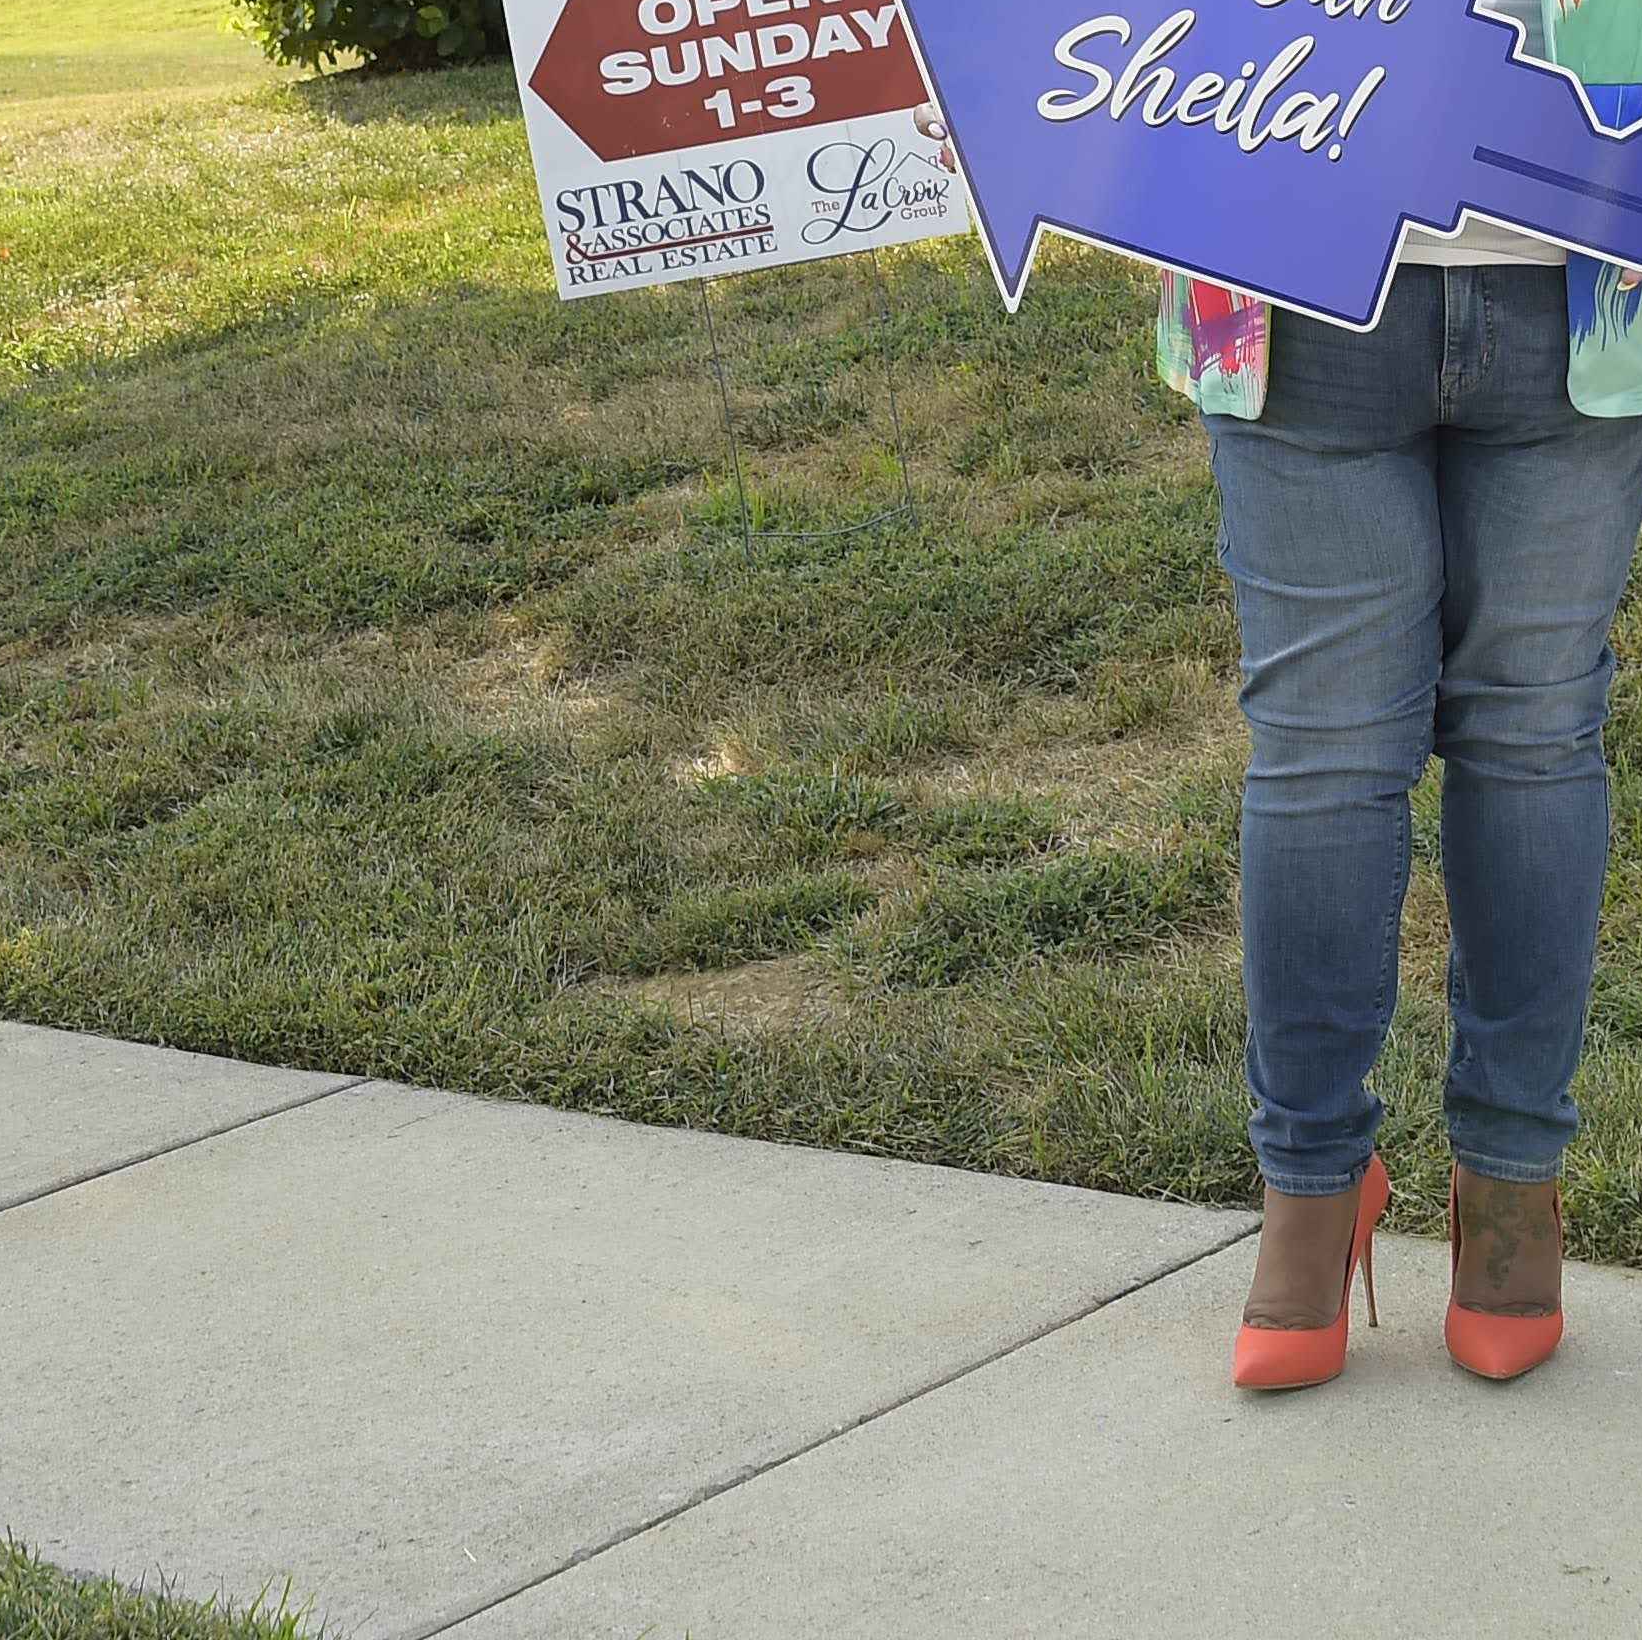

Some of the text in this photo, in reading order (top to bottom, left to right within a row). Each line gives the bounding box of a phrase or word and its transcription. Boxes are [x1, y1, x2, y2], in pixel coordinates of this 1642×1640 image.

[599, 4, 897, 95] SUNDAY
[703, 75, 816, 129] 1-3
[1036, 9, 1387, 163] Sheila!
[556, 159, 765, 234] STRANO
[811, 199, 840, 214] The
[900, 204, 948, 220] Group
[567, 233, 778, 286] REAL ESTATE
